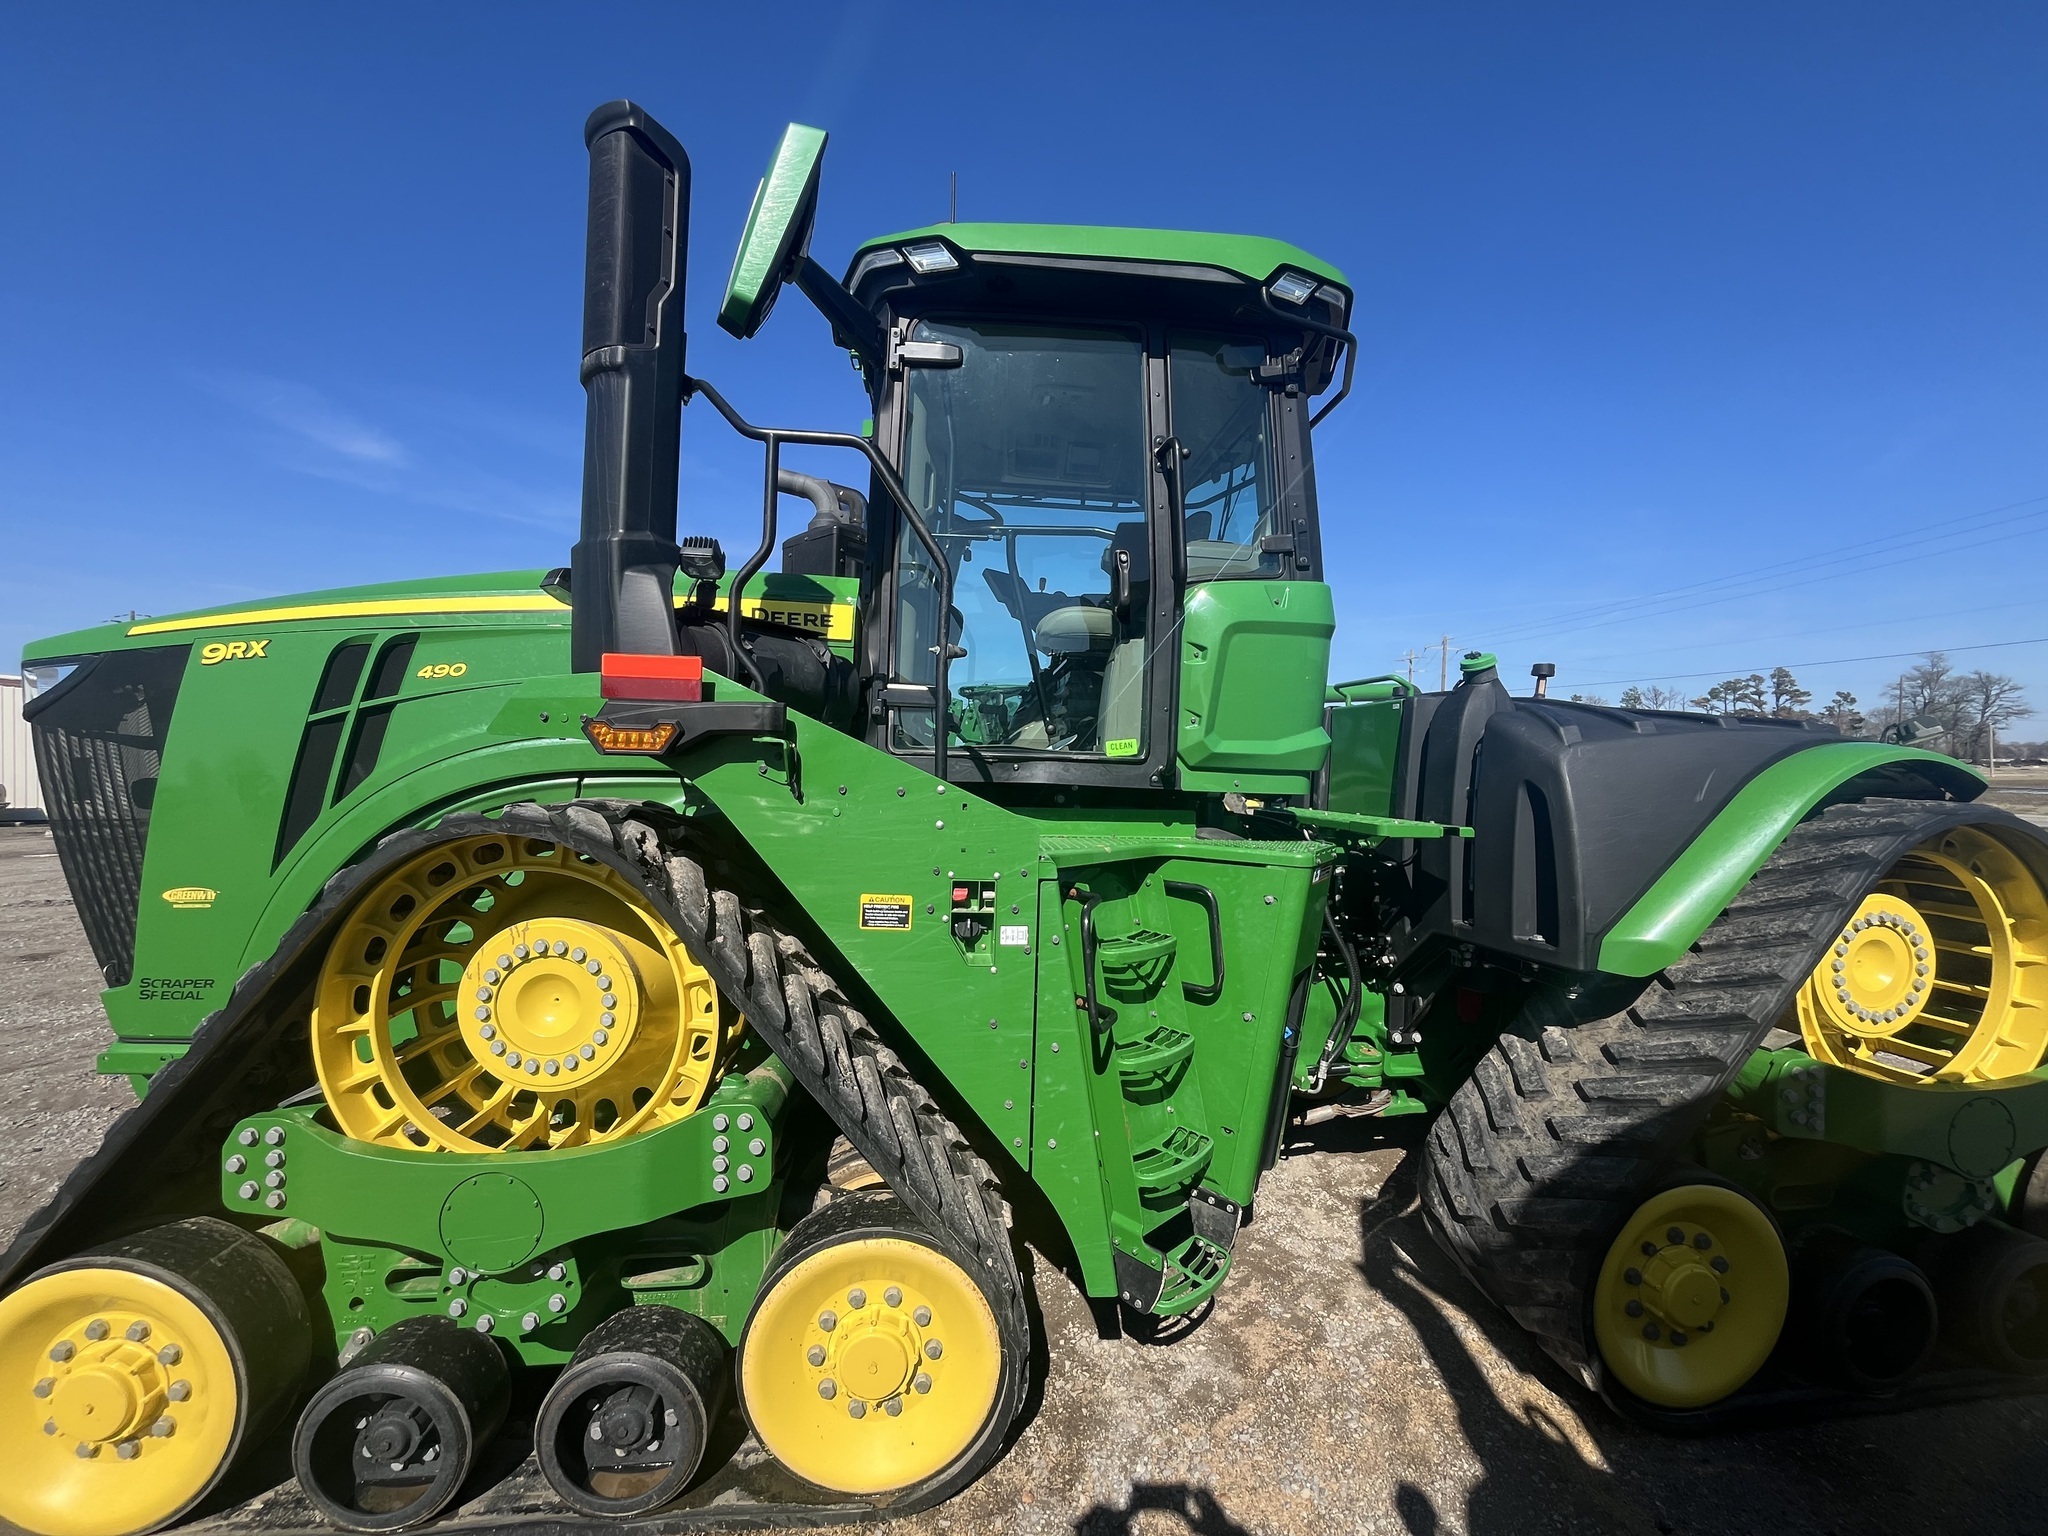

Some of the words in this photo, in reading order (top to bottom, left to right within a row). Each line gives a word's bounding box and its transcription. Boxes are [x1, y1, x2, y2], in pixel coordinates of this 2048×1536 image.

[751, 607, 834, 628] DEERE
[201, 639, 271, 665] 9RX
[416, 662, 468, 679] 490
[1110, 742, 1133, 751] CLEAN
[139, 978, 214, 988] SCRAPER
